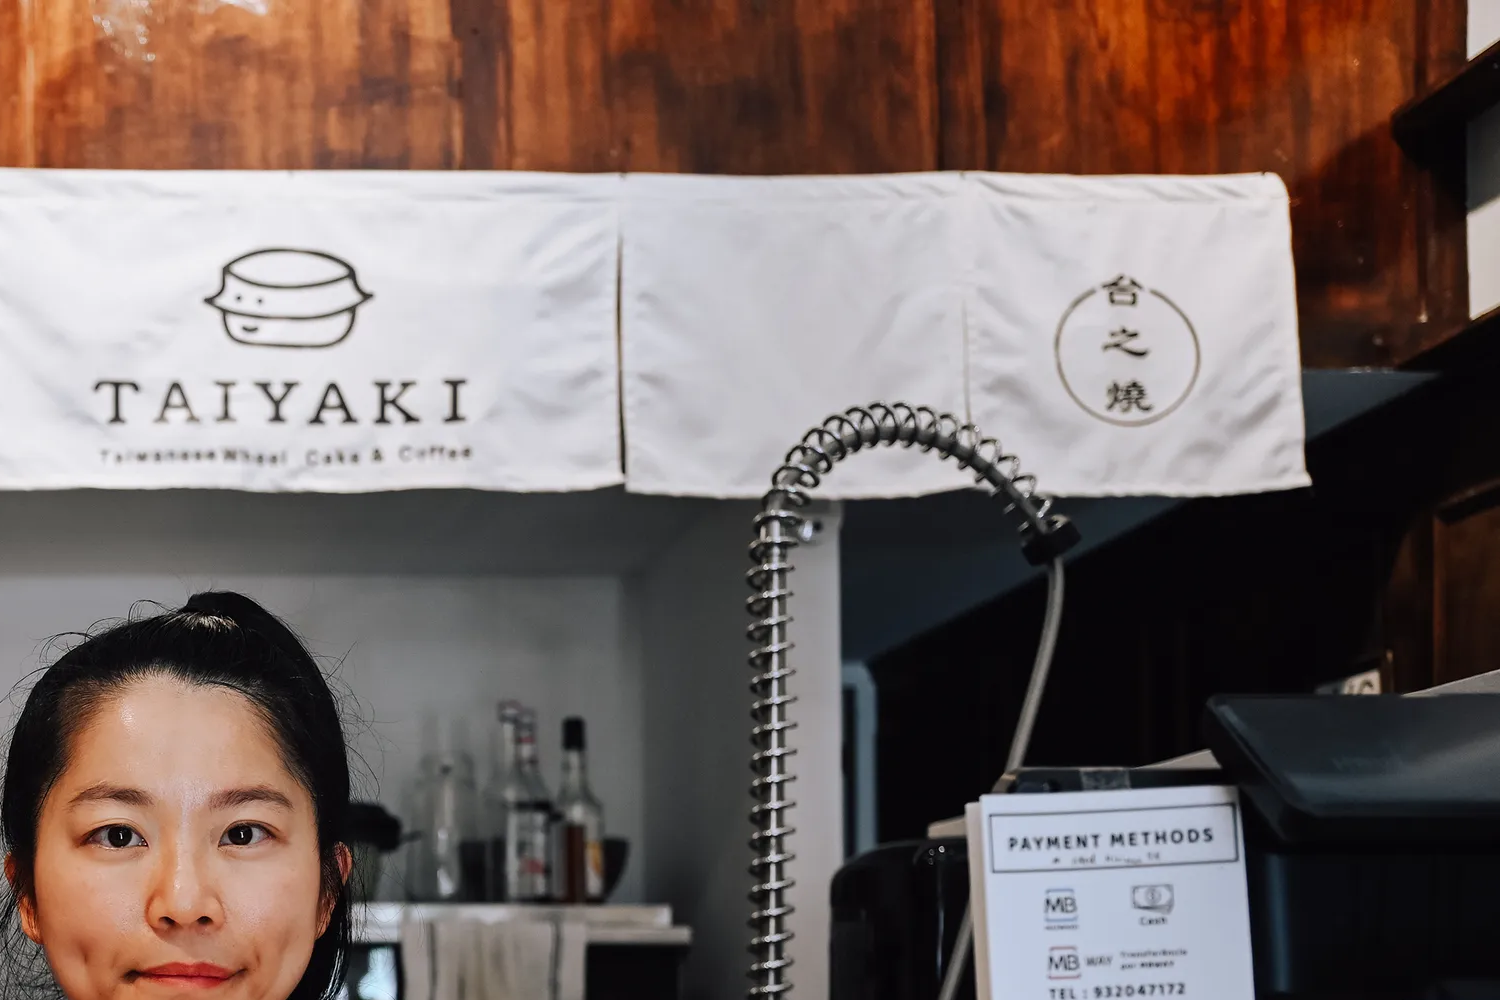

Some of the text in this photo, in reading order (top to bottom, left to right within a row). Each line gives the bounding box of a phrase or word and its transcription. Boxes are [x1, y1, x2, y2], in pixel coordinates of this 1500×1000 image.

[94, 380, 467, 425] TAIYAKI
[100, 443, 473, 466] Taiwanese Wheel Cake & Coffee
[1008, 827, 1214, 851] PAYMENT METHODS
[1045, 896, 1077, 914] MB
[1140, 915, 1168, 926] Cash
[1049, 953, 1079, 971] MB
[1050, 989, 1077, 1000] TEL
[1093, 983, 1186, 998] 932047172
